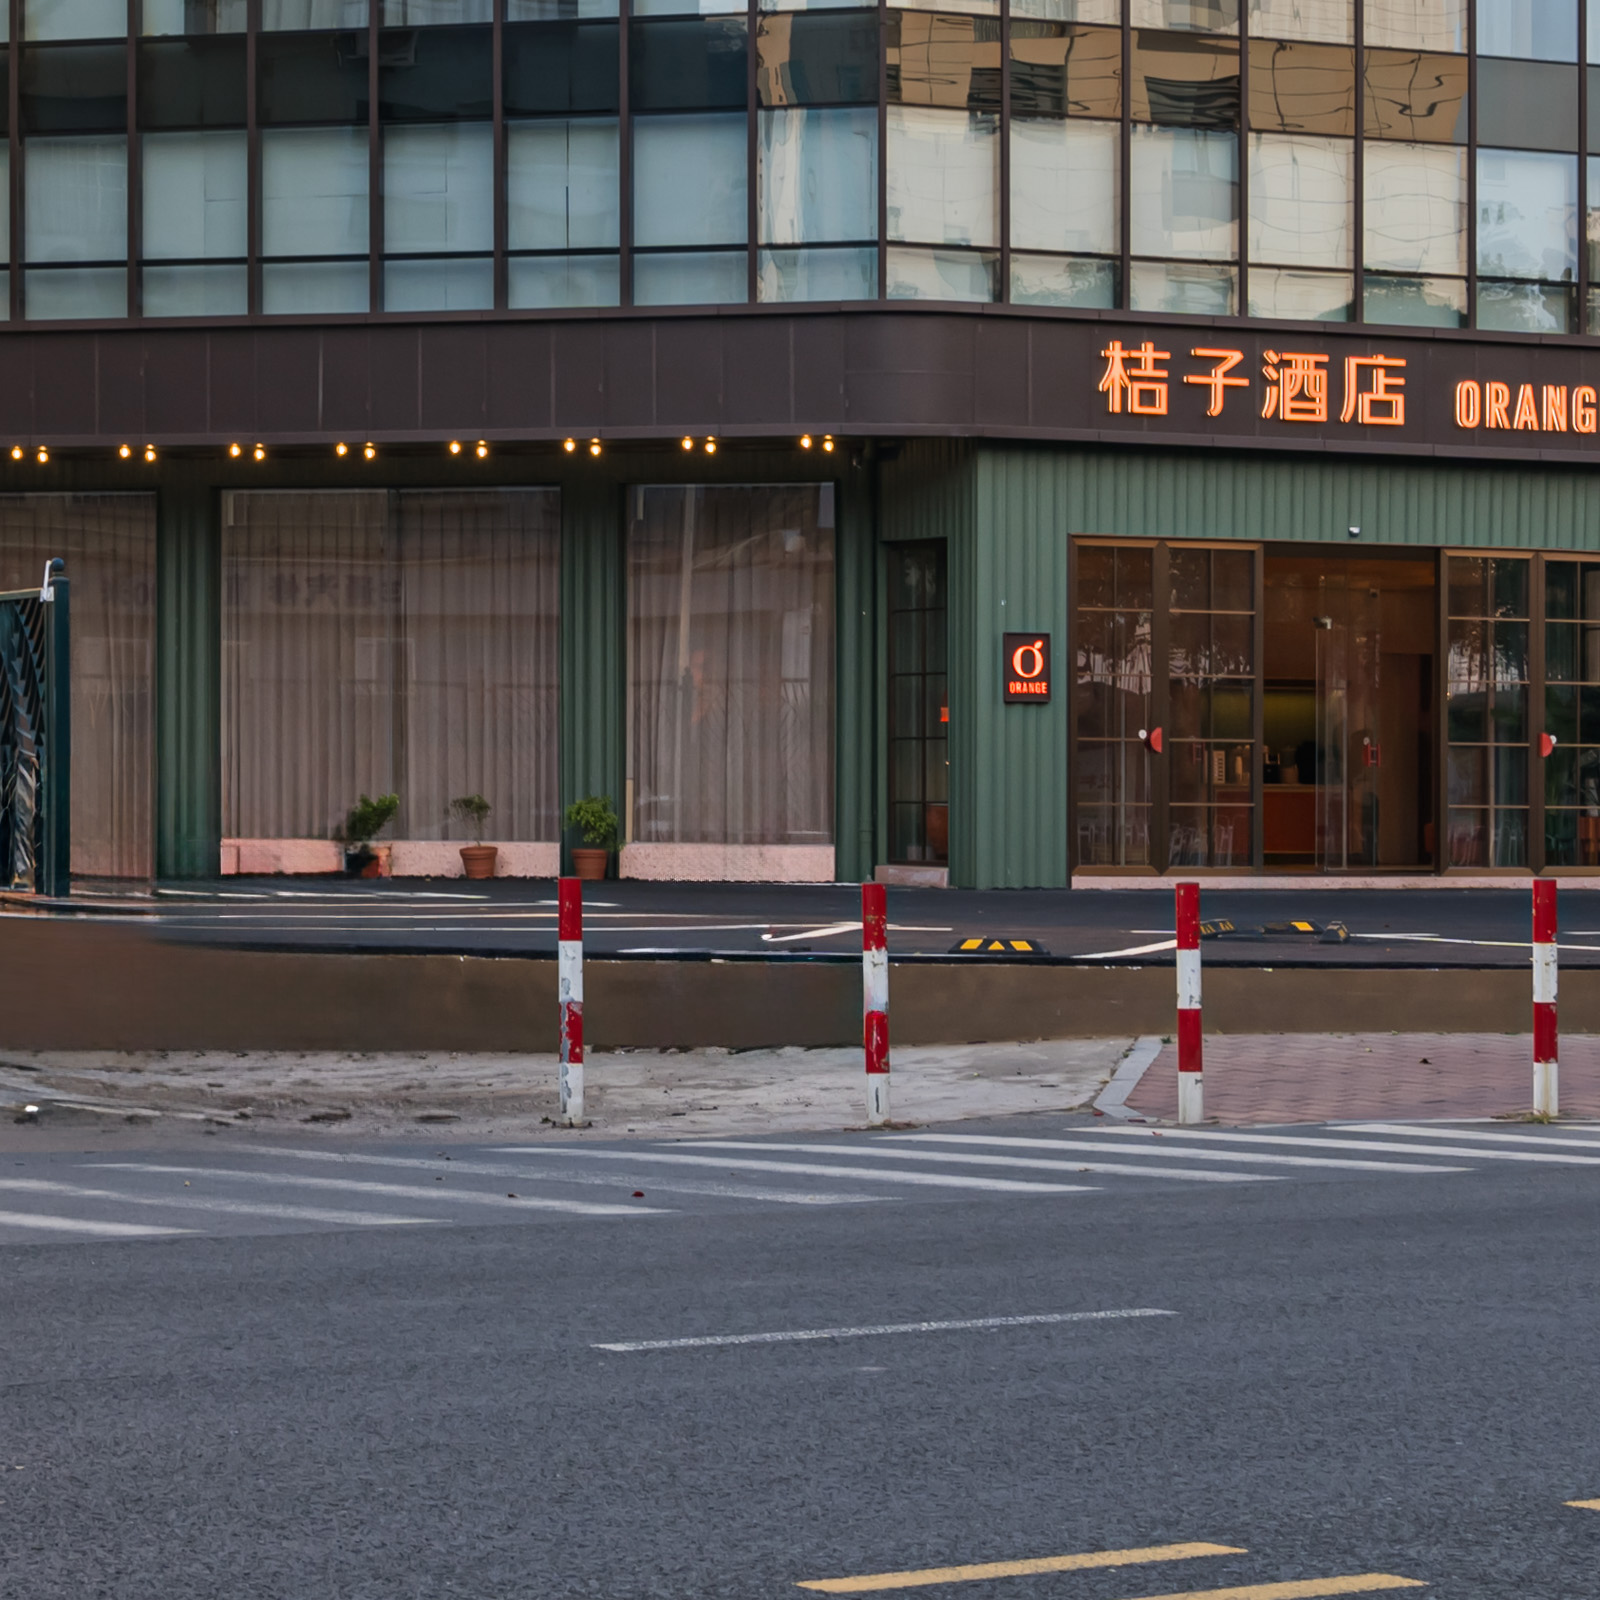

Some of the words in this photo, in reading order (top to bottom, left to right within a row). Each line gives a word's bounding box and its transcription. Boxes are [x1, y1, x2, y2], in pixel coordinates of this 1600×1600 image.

[1098, 340, 1407, 427] 桔子酒店
[1008, 681, 1047, 694] ORANGE
